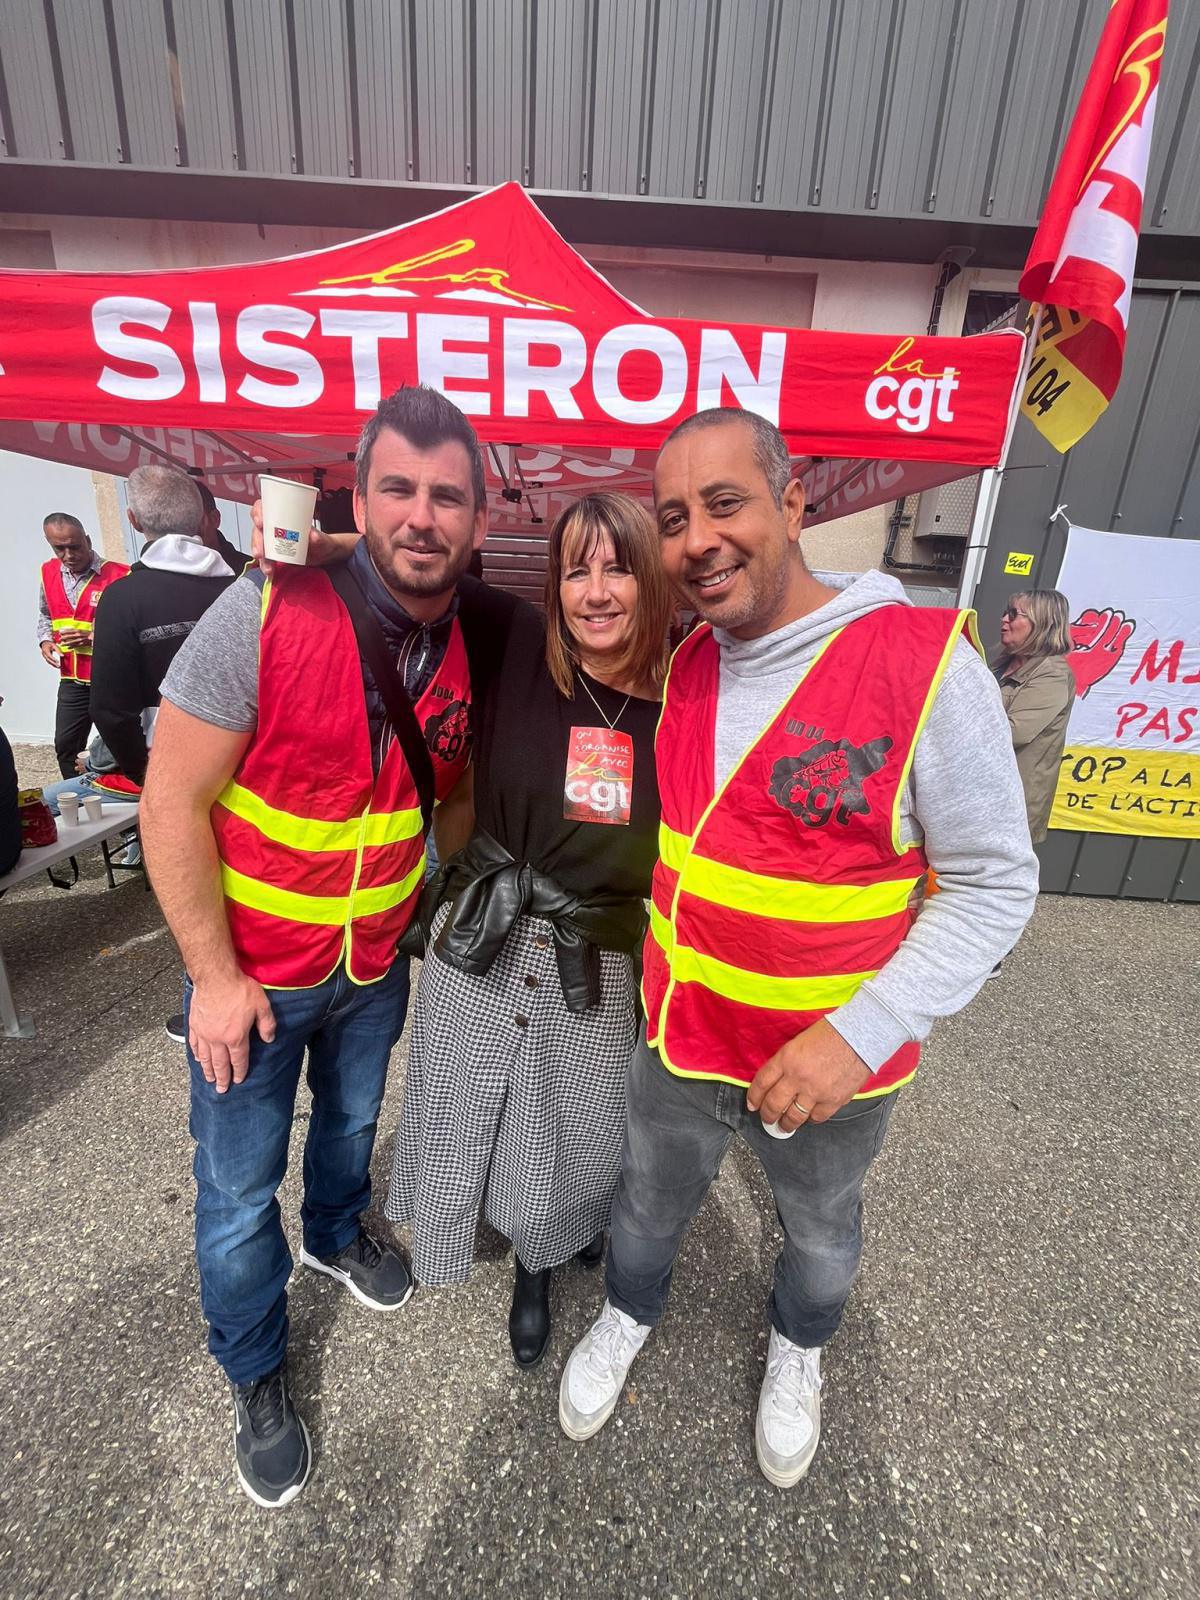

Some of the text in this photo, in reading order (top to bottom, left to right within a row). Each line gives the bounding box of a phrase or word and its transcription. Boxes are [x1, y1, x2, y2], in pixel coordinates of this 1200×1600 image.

[91, 296, 786, 428] SISTERON
[873, 336, 960, 377] la
[864, 366, 959, 433] cgt
[1130, 639, 1200, 685] M
[1116, 702, 1199, 743] PAS
[565, 780, 631, 812] cgt
[1131, 768, 1147, 785] A
[1160, 769, 1192, 788] LA
[1066, 792, 1200, 817] DE L'ACTI
